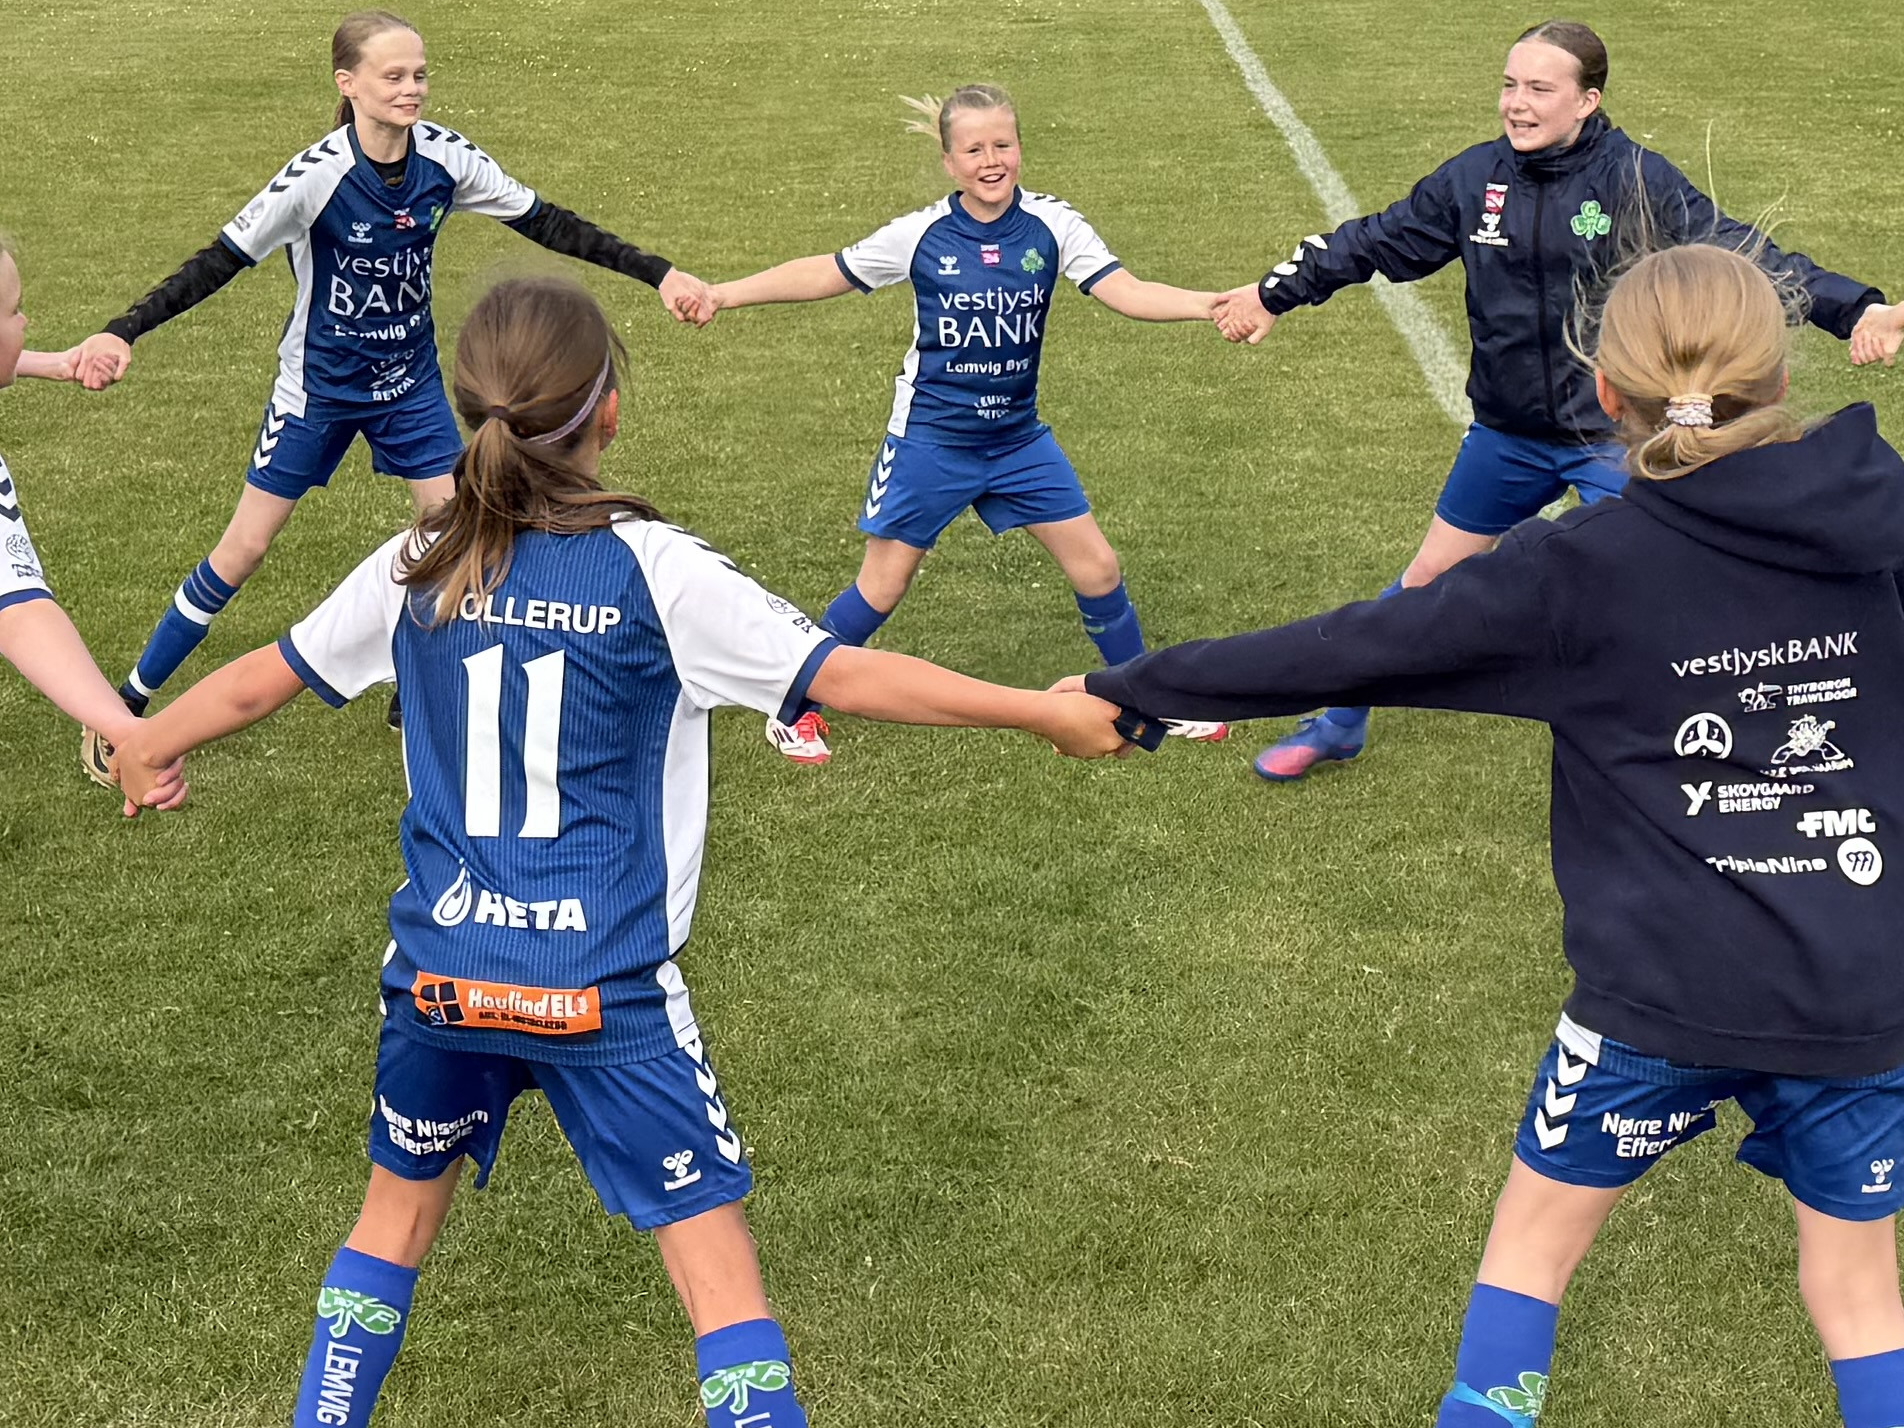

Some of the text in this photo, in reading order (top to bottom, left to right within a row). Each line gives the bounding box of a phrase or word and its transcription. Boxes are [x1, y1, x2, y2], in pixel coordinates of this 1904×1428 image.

[328, 273, 431, 319] BAN
[938, 283, 1045, 315] vestjysk
[938, 309, 1042, 348] BANK
[436, 590, 621, 635] OLLERUP
[462, 643, 566, 839] 11
[1717, 782, 1815, 799] SKOVGAARD
[1718, 796, 1781, 813] ENERGY
[1797, 808, 1876, 838] FMC
[474, 889, 587, 932] HETA
[416, 1109, 488, 1138] Nissum
[1601, 1111, 1663, 1138] Nørre
[1616, 1137, 1678, 1158] Efter
[316, 1340, 363, 1427] LEMVIG
